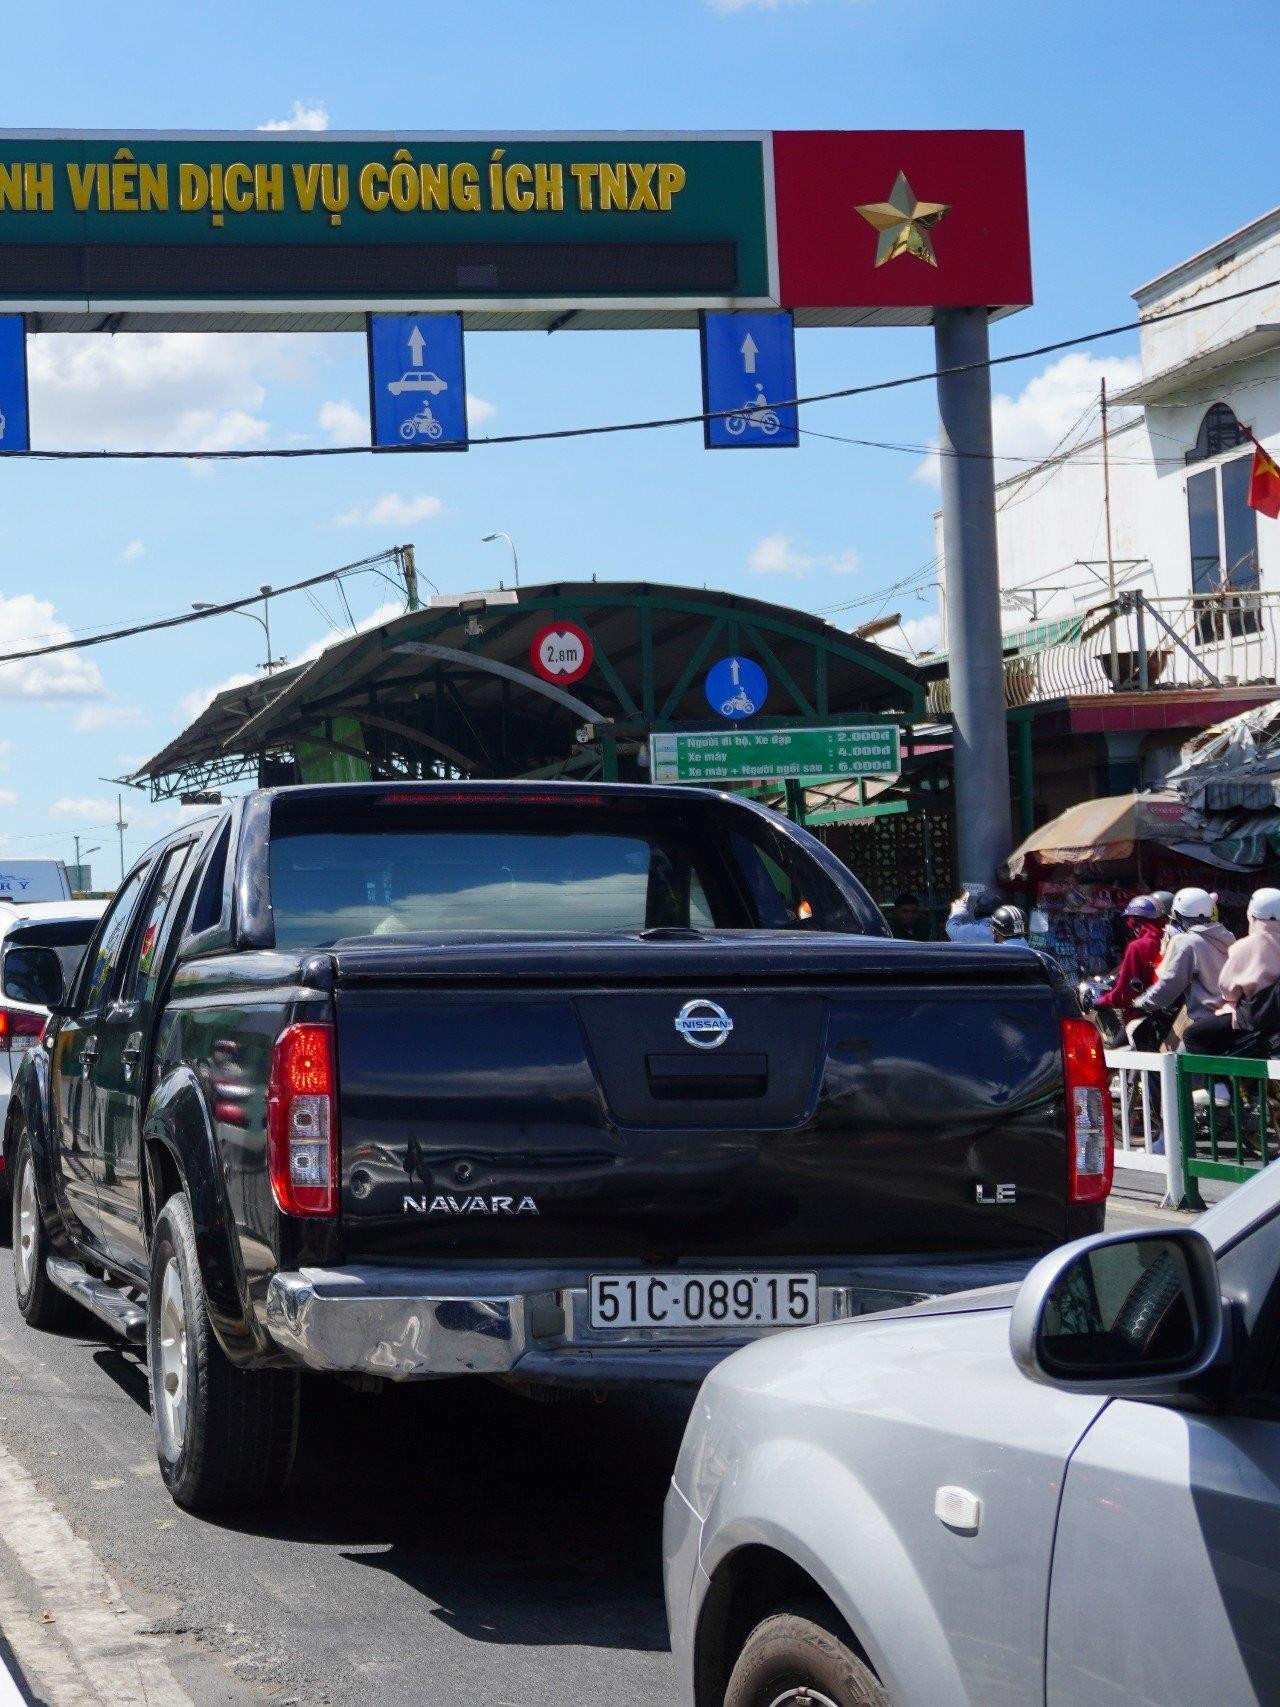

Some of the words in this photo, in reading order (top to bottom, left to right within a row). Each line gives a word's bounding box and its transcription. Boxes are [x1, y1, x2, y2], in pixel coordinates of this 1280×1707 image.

[66, 147, 169, 212] VIÊN
[178, 163, 284, 227] DỊCH
[291, 163, 351, 227] VỤ
[359, 148, 481, 212] CÔNG
[488, 148, 563, 212] ÍCH
[571, 163, 687, 212] TNXP
[687, 736, 719, 749] Người
[722, 736, 732, 747] đi
[755, 735, 769, 745] Xe
[771, 734, 792, 746] đạp
[837, 731, 890, 742] 2.000đ
[688, 752, 701, 762] Xe
[704, 752, 728, 763] máy
[838, 745, 891, 757] 4.000đ
[688, 767, 701, 776] Xe
[705, 766, 728, 777] máy
[742, 764, 773, 775] Người
[776, 762, 800, 775] ngồi
[803, 763, 823, 773] sau
[682, 1020, 728, 1029] NISSAN
[975, 1183, 1017, 1204] LE
[402, 1195, 540, 1215] NAVARA
[598, 1278, 810, 1323] 51C-089.15
